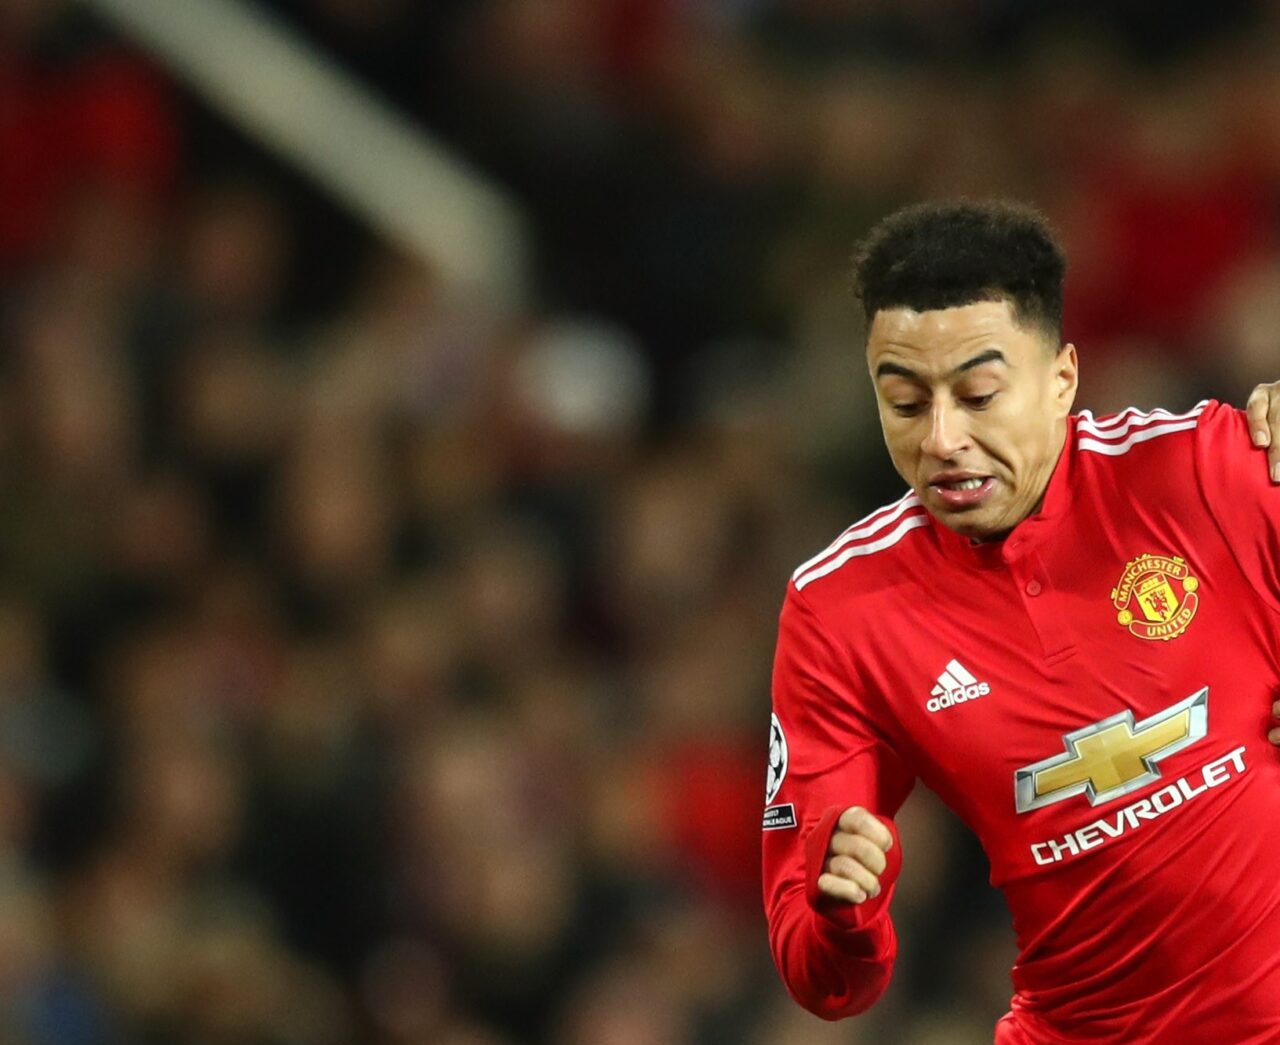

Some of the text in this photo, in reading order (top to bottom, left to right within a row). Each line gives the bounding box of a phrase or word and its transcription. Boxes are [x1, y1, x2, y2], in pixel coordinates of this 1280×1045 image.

[1118, 559, 1182, 603] MANCHESTER
[1146, 608, 1192, 637] UNITED
[926, 682, 991, 713] adidas
[1030, 746, 1247, 866] CHEVROLET
